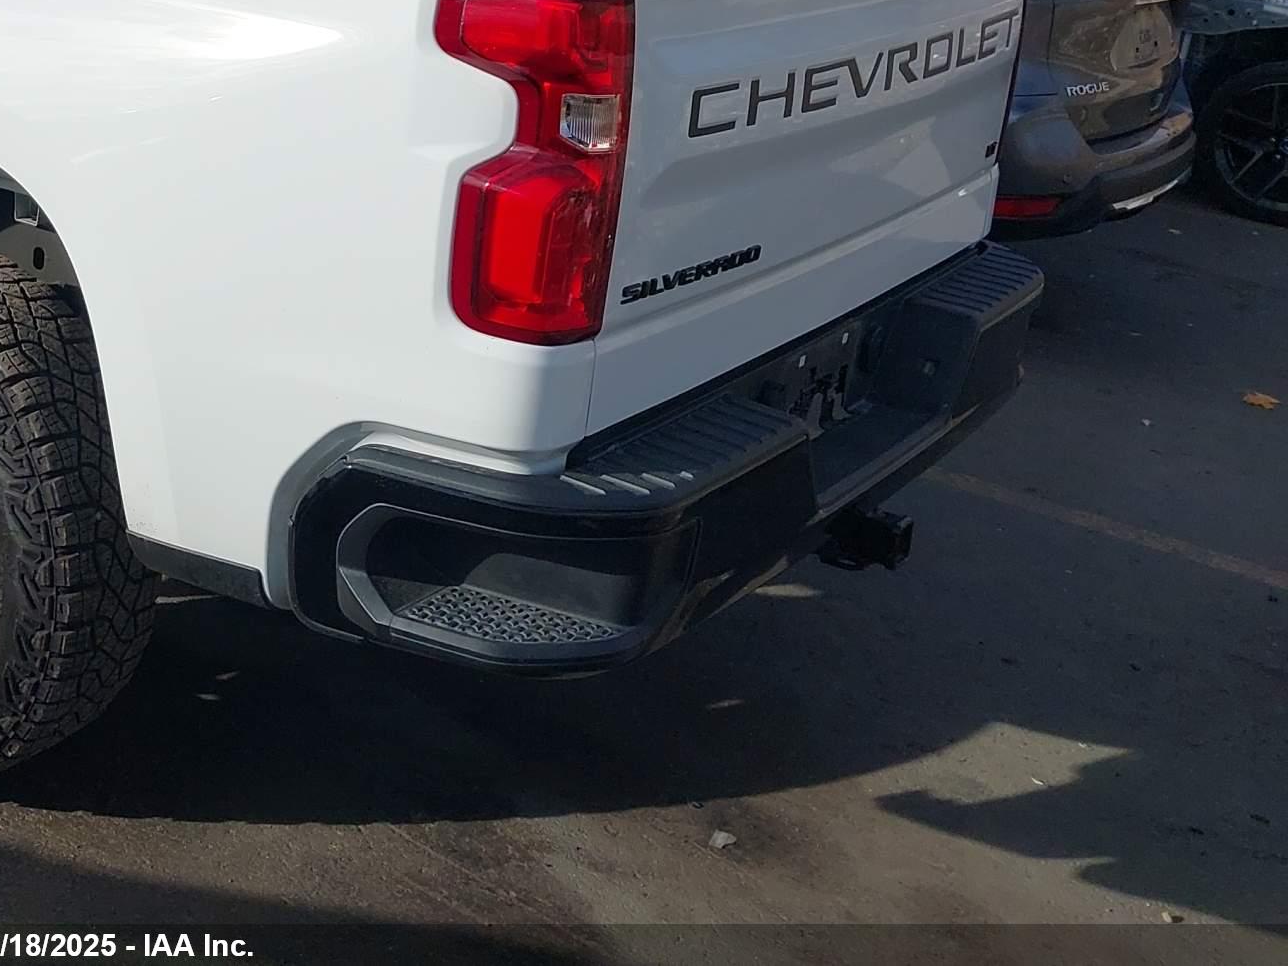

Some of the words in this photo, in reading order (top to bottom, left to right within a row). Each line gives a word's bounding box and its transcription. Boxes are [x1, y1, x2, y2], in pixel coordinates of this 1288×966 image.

[688, 9, 1019, 138] CHEVROLET
[1066, 81, 1110, 97] ROGUE
[620, 244, 762, 305] SILVERADO
